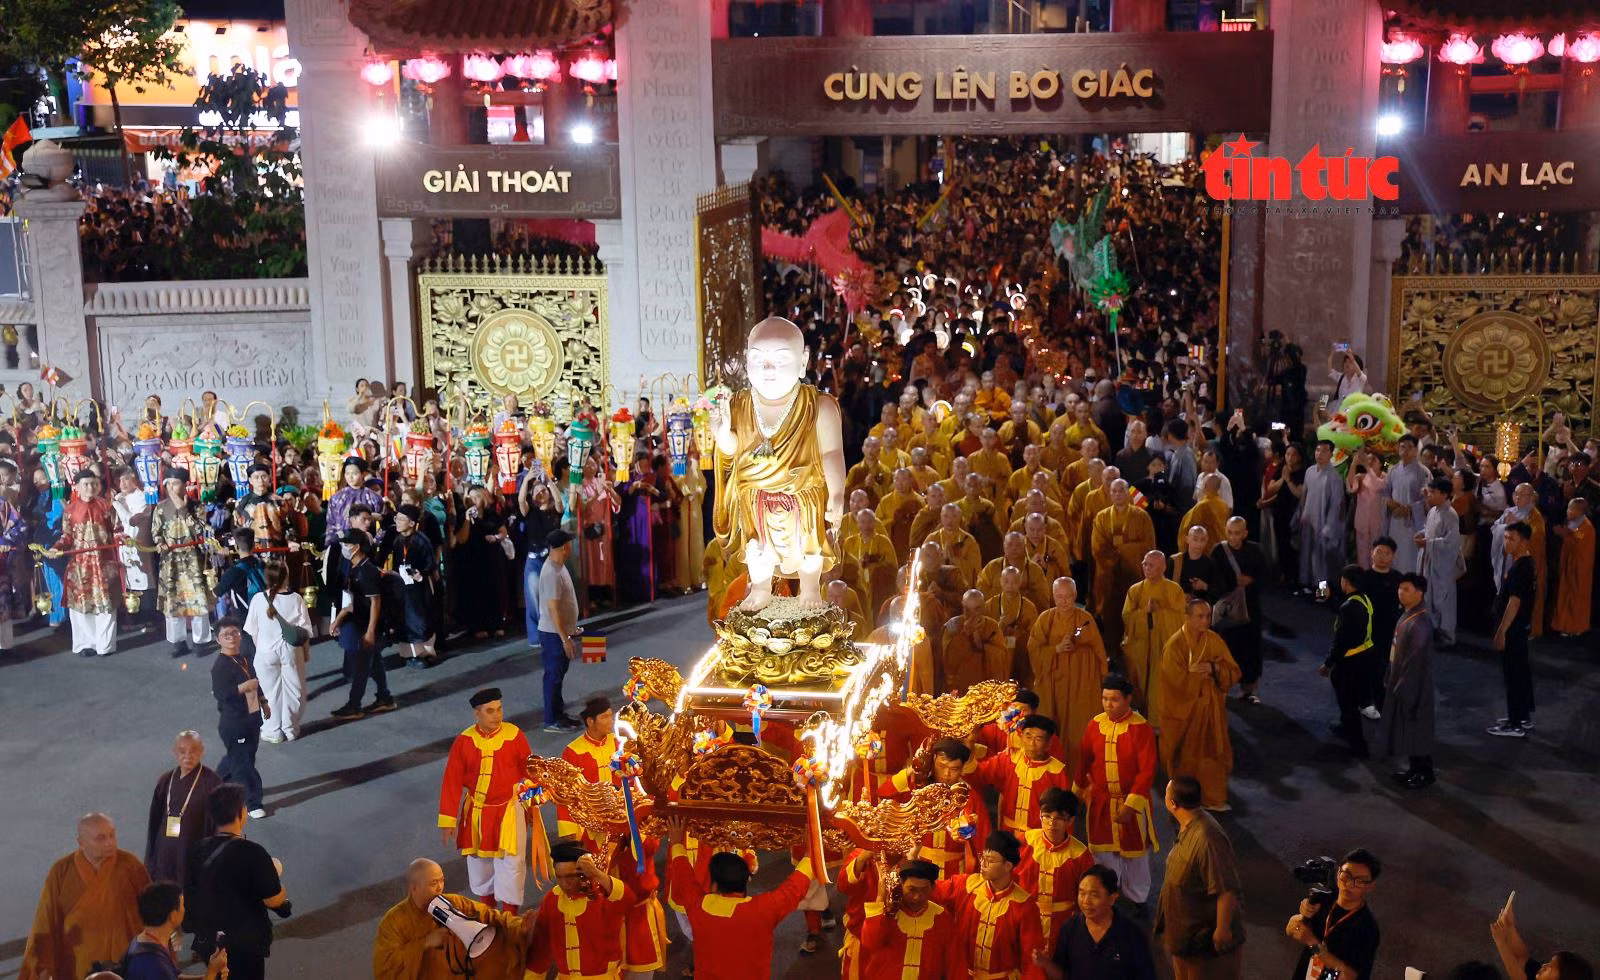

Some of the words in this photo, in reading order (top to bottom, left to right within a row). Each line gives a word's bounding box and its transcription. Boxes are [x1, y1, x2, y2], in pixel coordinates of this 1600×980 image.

[823, 64, 923, 100] CÙNG
[935, 64, 996, 99] LÊN
[1009, 63, 1060, 99] BỜ
[1071, 62, 1153, 98] GIÁC
[423, 163, 480, 193] GIẢI
[487, 165, 572, 193] THOÁT
[1460, 163, 1509, 186] AN
[1520, 161, 1575, 190] LẠC
[129, 371, 205, 391] TRANG
[212, 365, 296, 389] NGHIÊM
